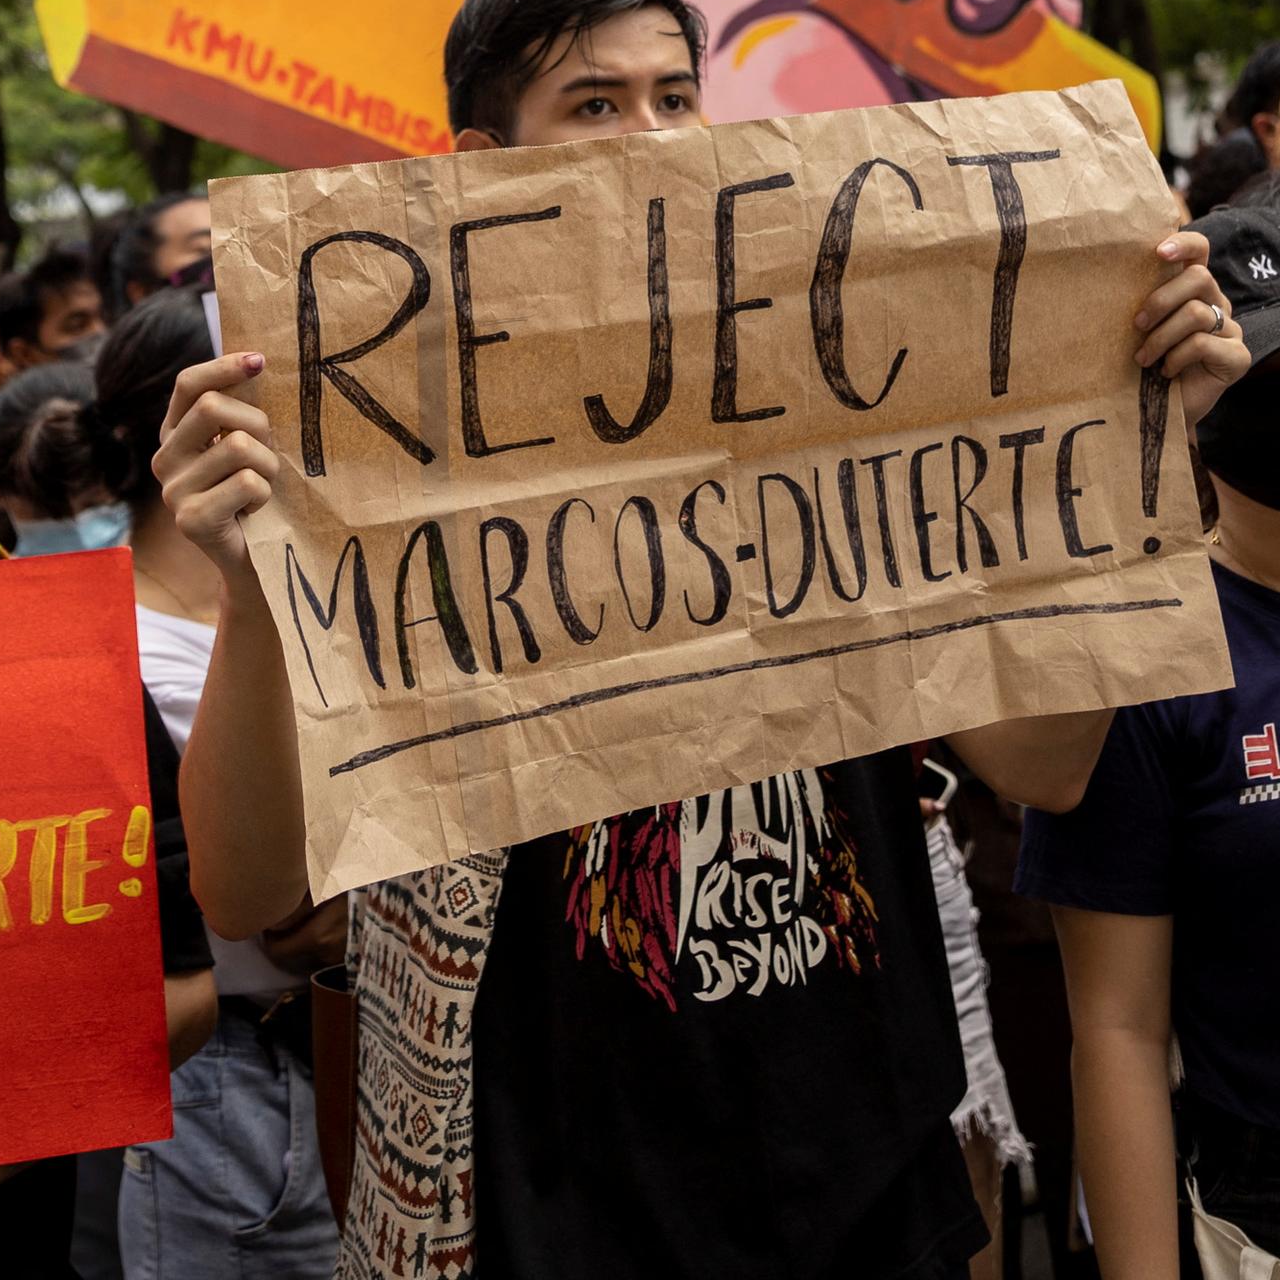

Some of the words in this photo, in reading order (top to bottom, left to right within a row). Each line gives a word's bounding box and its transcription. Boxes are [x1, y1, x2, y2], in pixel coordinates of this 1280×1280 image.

[297, 149, 1062, 478] REJECT
[285, 361, 1173, 707] MARCOS-DUTERTE!
[695, 860, 793, 930] RISE
